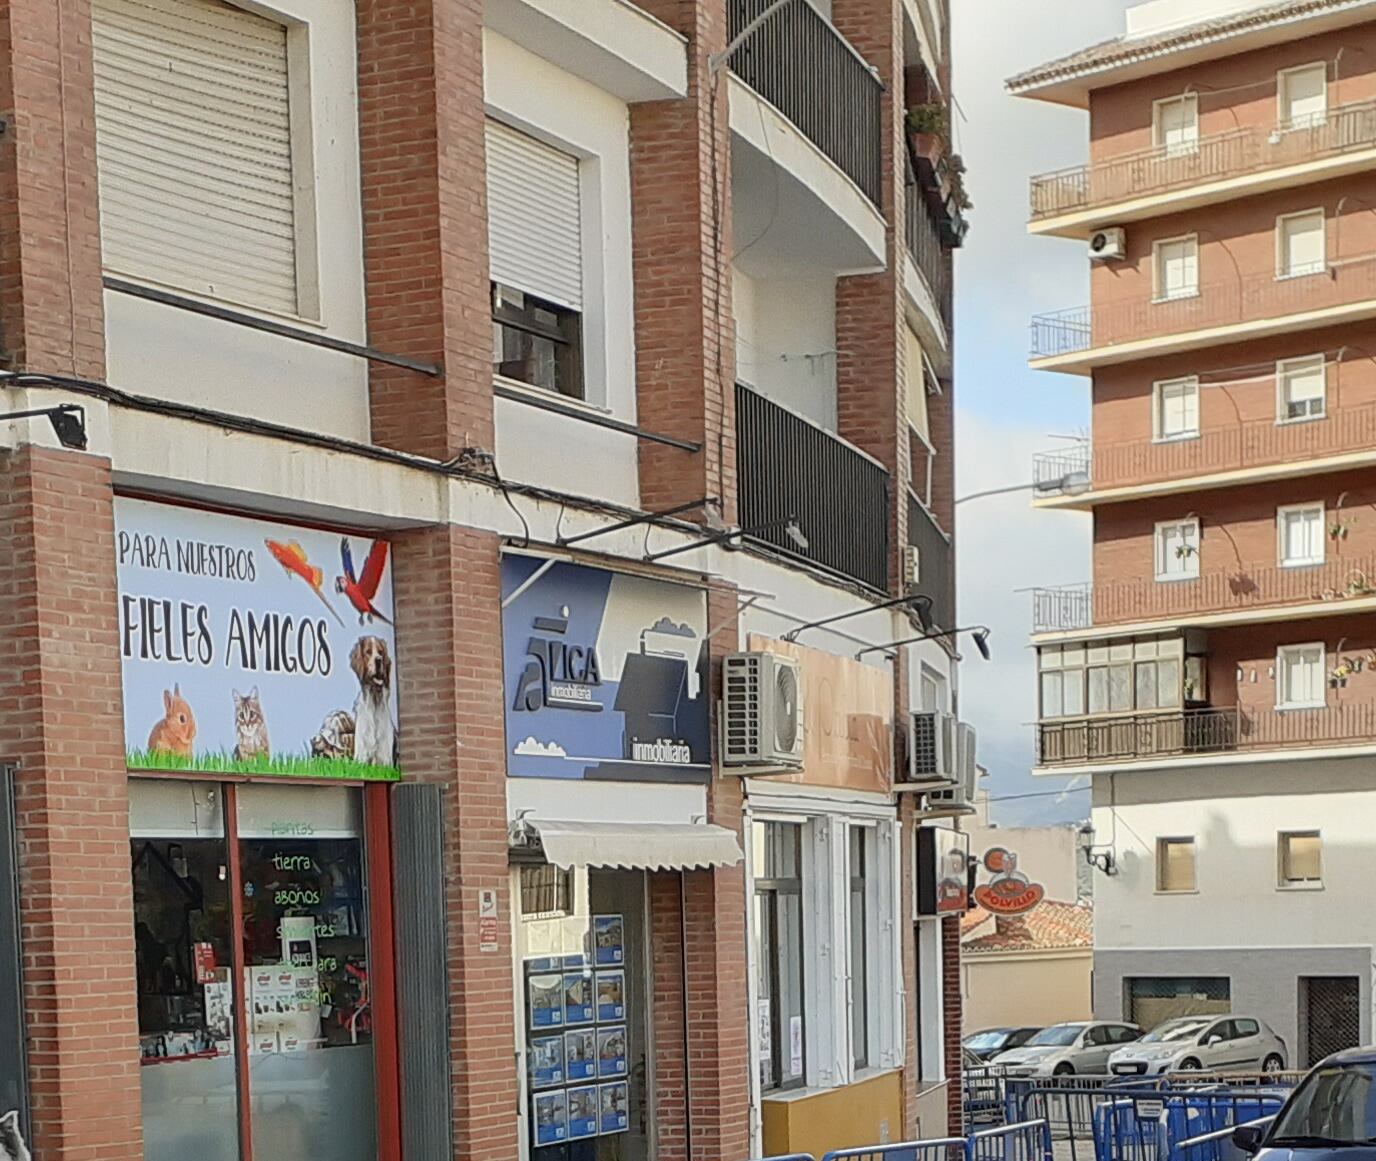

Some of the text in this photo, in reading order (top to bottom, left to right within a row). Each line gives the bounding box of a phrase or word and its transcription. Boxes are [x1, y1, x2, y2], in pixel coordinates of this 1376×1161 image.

[118, 530, 257, 583] PARA NUESTROS
[122, 594, 332, 677] FIELES AMIGOS
[271, 852, 312, 871] tierra
